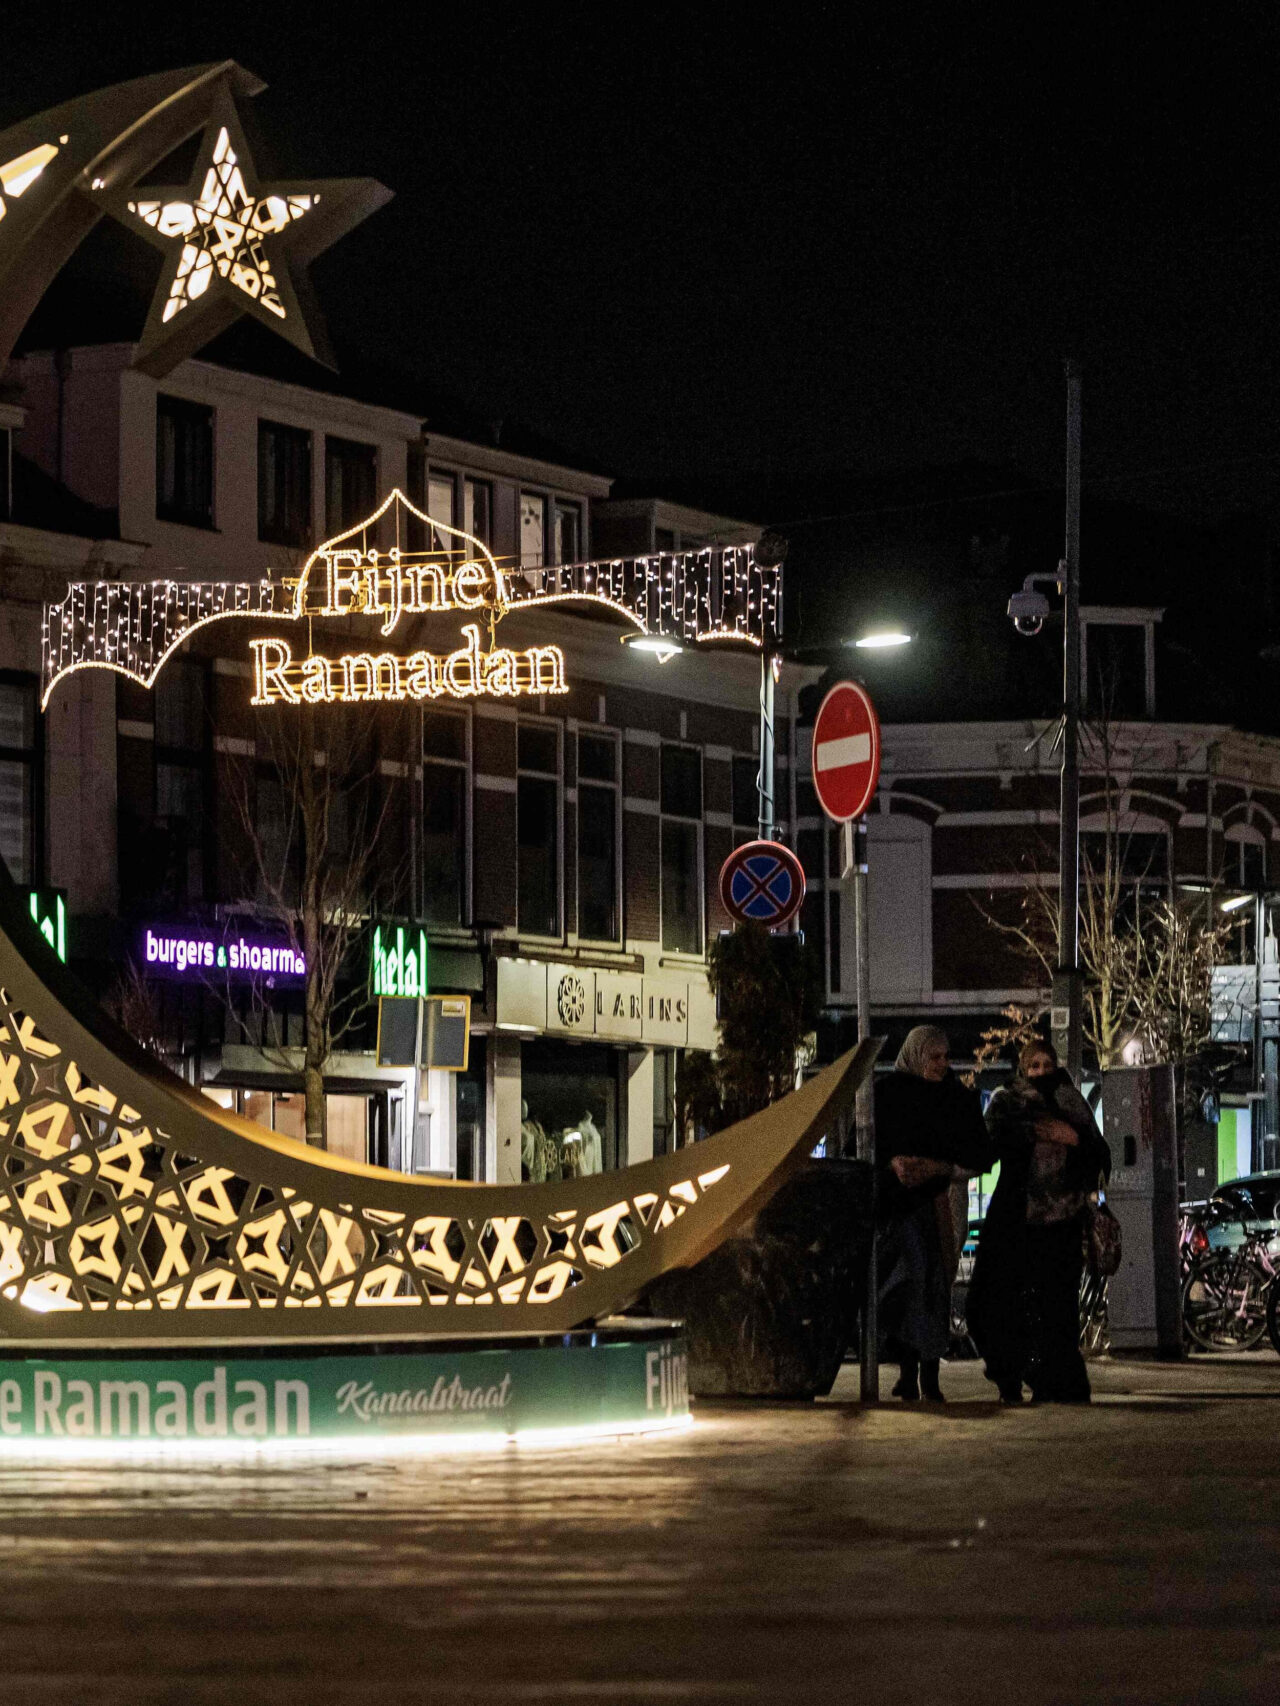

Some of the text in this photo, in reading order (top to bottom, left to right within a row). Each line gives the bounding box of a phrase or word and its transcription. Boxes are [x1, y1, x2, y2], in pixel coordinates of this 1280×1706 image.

[319, 549, 487, 636] Fijne
[249, 624, 570, 705] Ramadan
[146, 929, 214, 971] burgers
[217, 945, 227, 967] &
[373, 925, 427, 997] helal
[34, 1367, 310, 1436] Ramadan
[335, 1373, 511, 1423] Kanaalstraat
